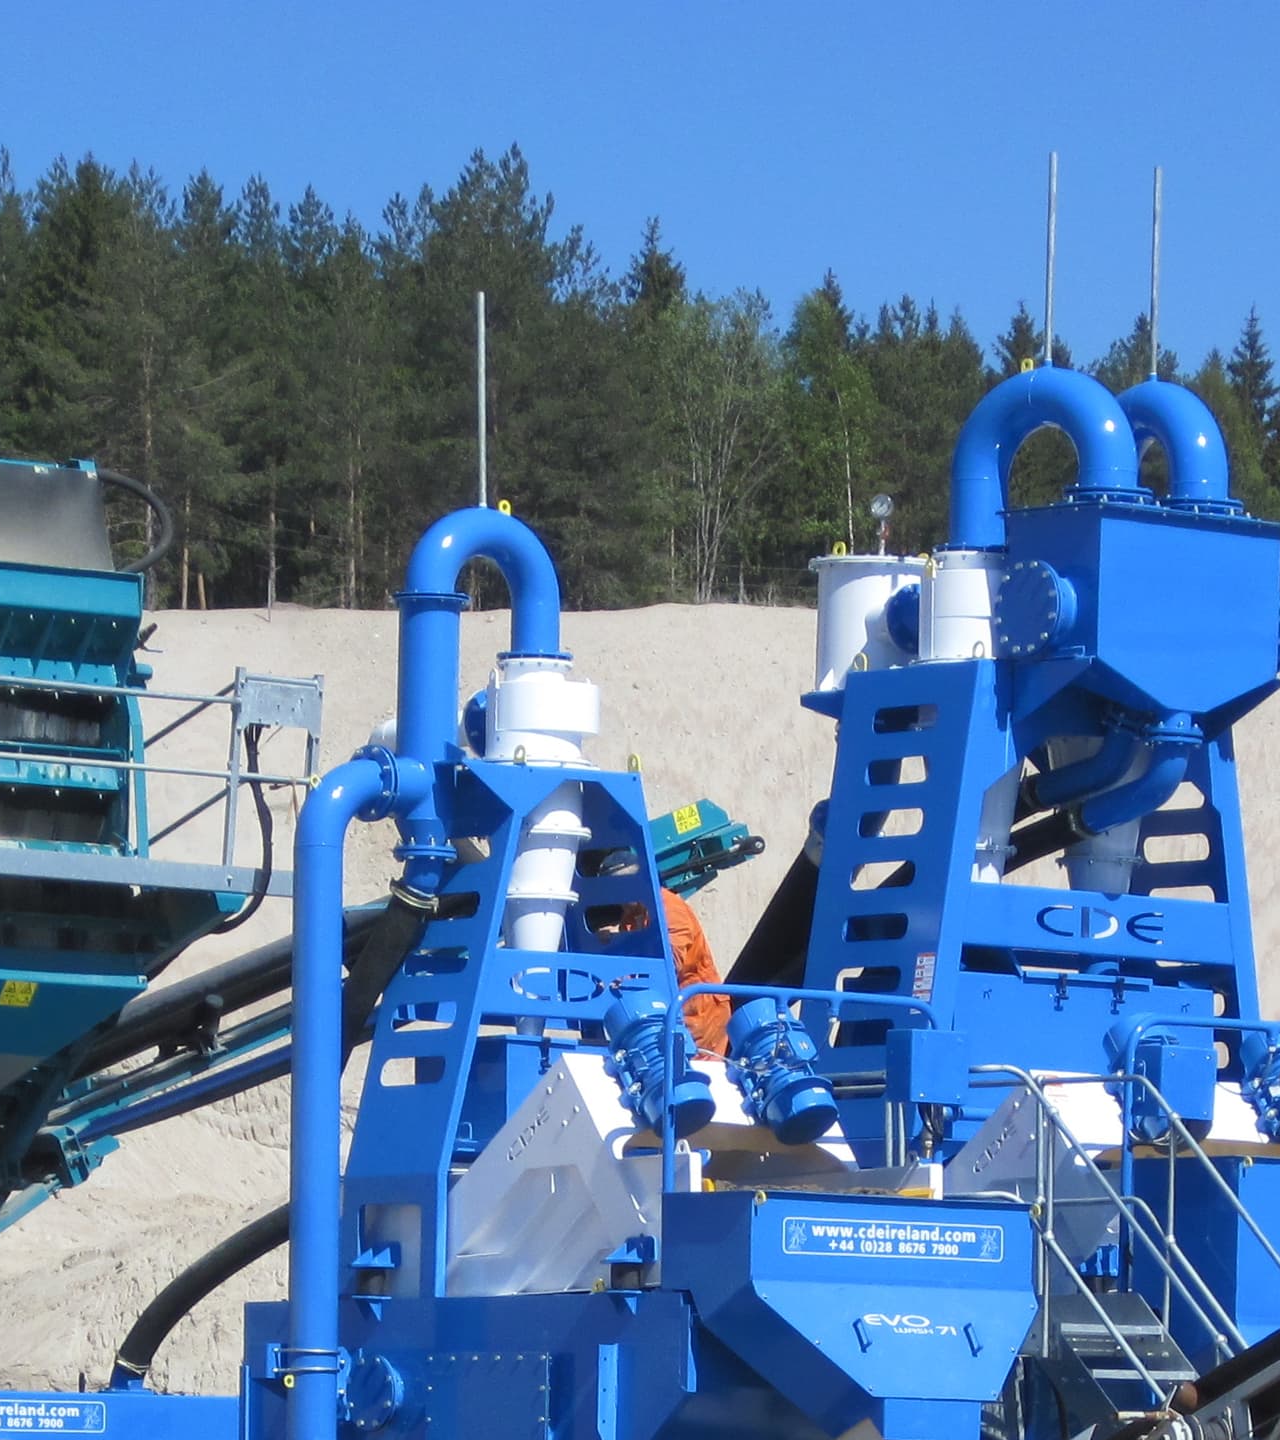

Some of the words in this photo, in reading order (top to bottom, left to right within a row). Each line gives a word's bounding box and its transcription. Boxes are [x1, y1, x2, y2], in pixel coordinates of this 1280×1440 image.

[1035, 904, 1165, 945] CDE
[811, 1223, 977, 1243] www.cdeireland.com
[828, 1239, 855, 1252] +44
[860, 1239, 893, 1253] (0)28
[898, 1242, 926, 1255] 8676
[931, 1243, 959, 1255] 7900
[863, 1313, 931, 1328] EVO
[893, 1326, 934, 1335] WASH
[7, 1417, 33, 1428] 8676
[38, 1418, 64, 1429] 7900
